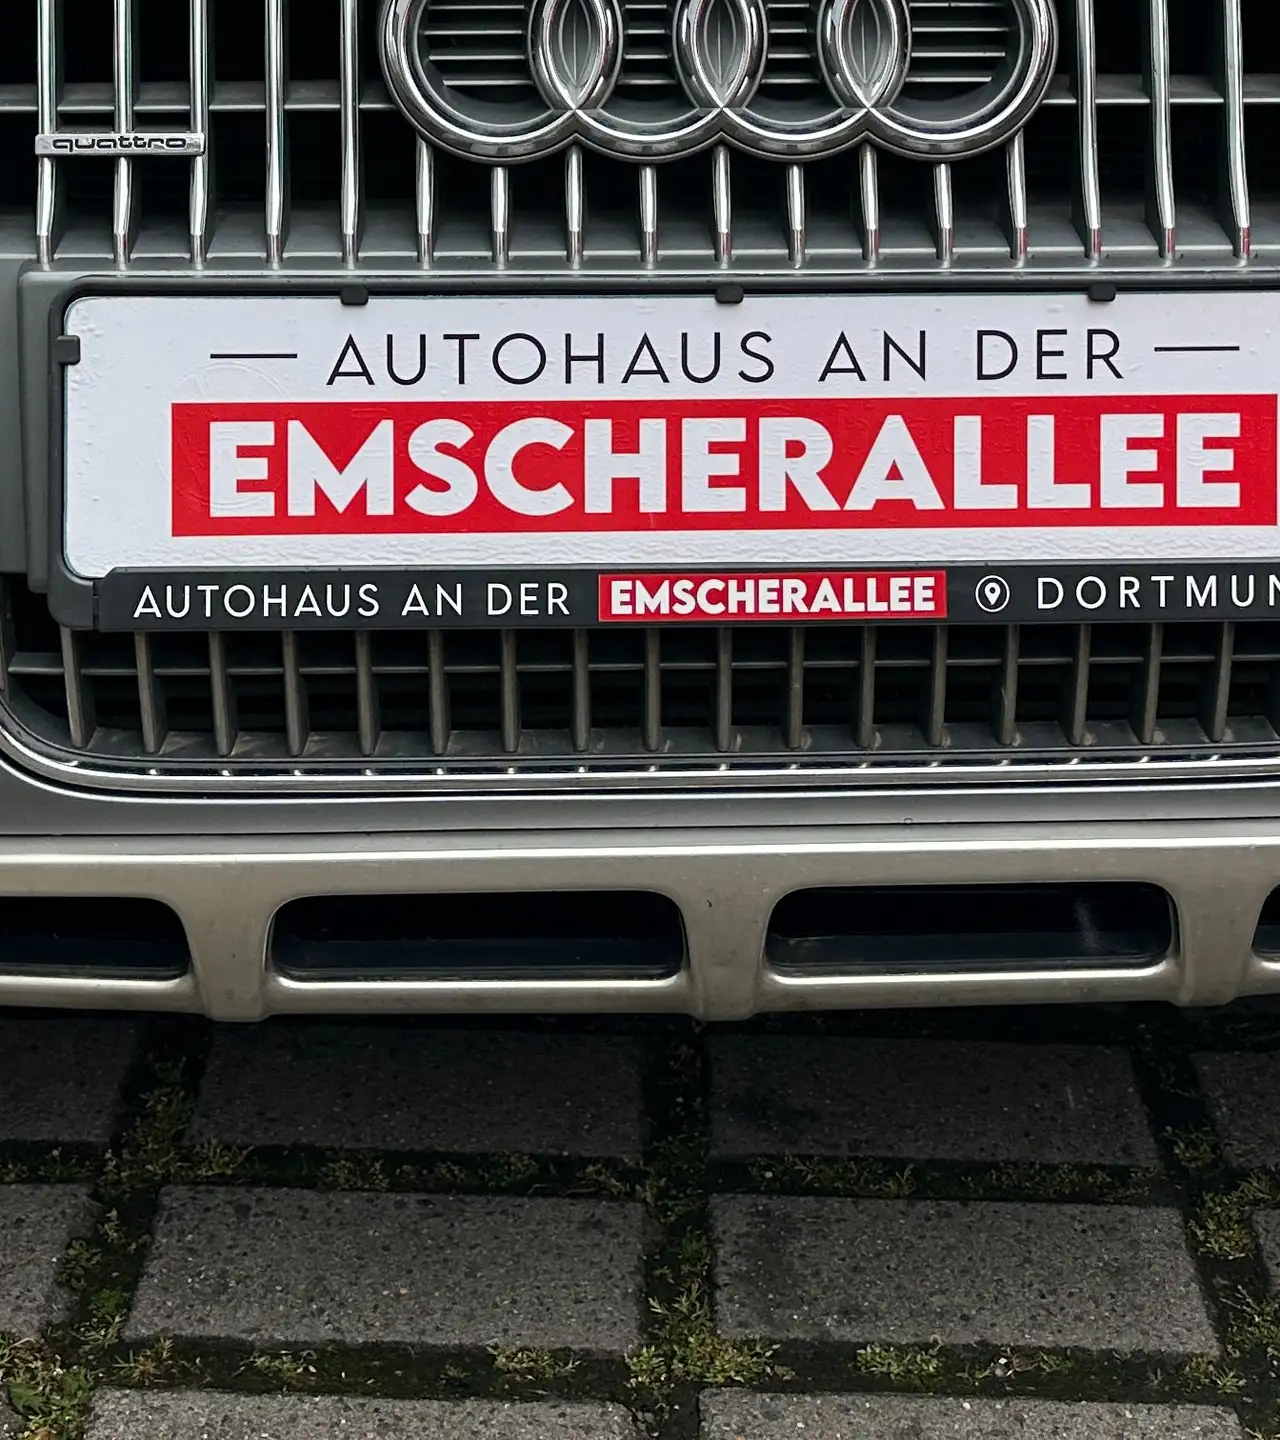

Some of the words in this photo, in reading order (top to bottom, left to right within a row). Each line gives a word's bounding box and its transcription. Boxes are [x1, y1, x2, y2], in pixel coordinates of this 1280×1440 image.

[52, 135, 188, 153] quattro
[325, 331, 776, 386] AUTOHAUS
[817, 330, 927, 383] AN
[976, 328, 1125, 382] DER
[208, 411, 1243, 519] EMSCHERALLEE
[132, 582, 381, 619] AUTOHAUS
[401, 582, 463, 618] AN
[487, 581, 571, 617] DER
[610, 575, 937, 616] EMSCHERALLEE
